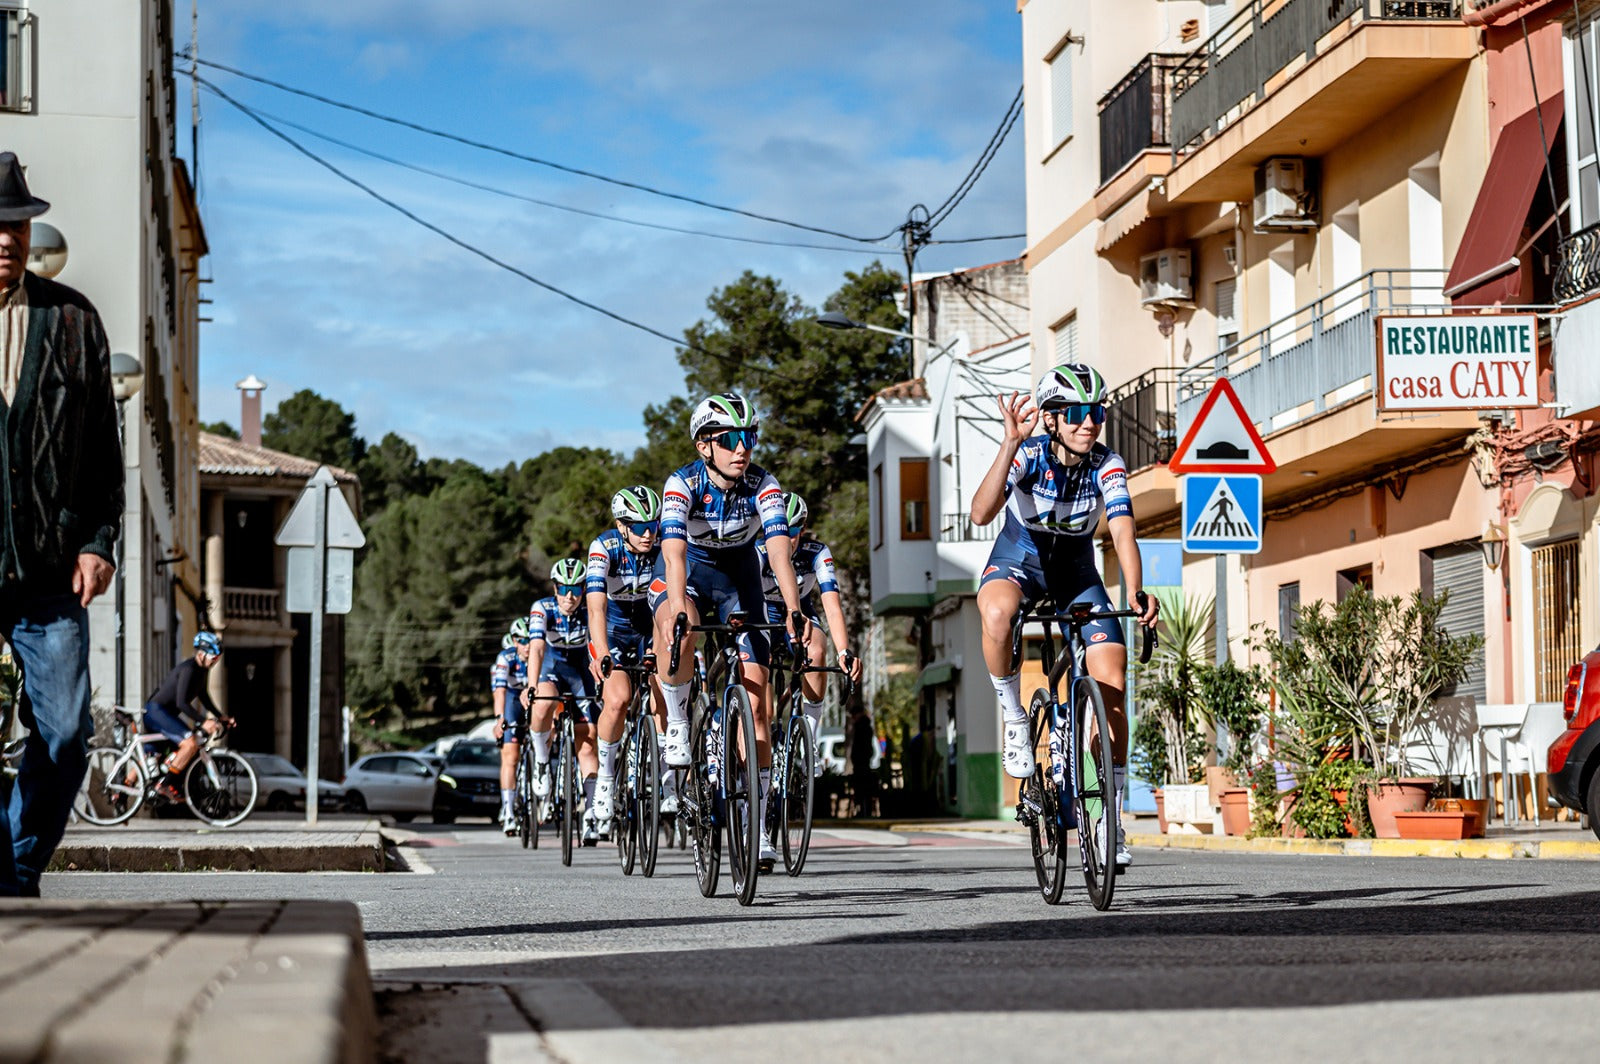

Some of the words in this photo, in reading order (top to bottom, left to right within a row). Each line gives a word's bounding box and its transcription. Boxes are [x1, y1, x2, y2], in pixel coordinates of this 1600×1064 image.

[1387, 325, 1531, 355] RESTAURANTE
[1389, 376, 1443, 399] casa
[1450, 360, 1531, 399] CATY
